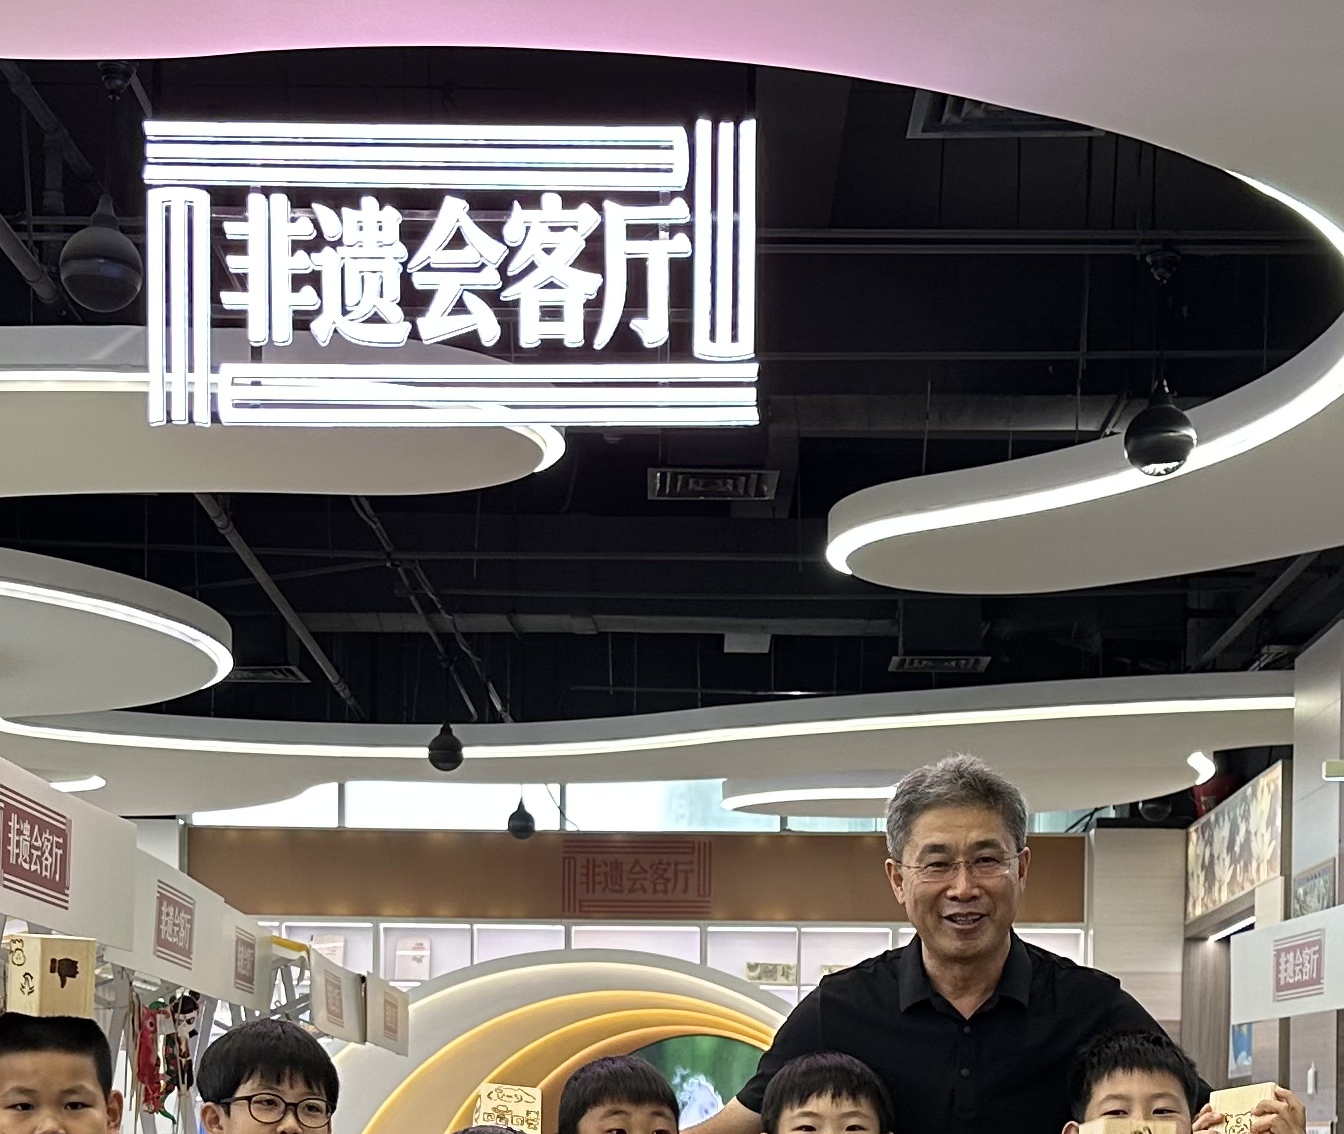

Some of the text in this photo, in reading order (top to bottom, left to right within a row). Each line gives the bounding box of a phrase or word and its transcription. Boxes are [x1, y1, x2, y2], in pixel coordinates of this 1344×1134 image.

[220, 193, 691, 350] 非遗会客厅
[6, 812, 63, 883] 非遗会客厅
[579, 857, 695, 895] 非遗会客厅
[160, 900, 192, 950] 非遗会客厅
[1278, 945, 1320, 985] 非遗会客厅
